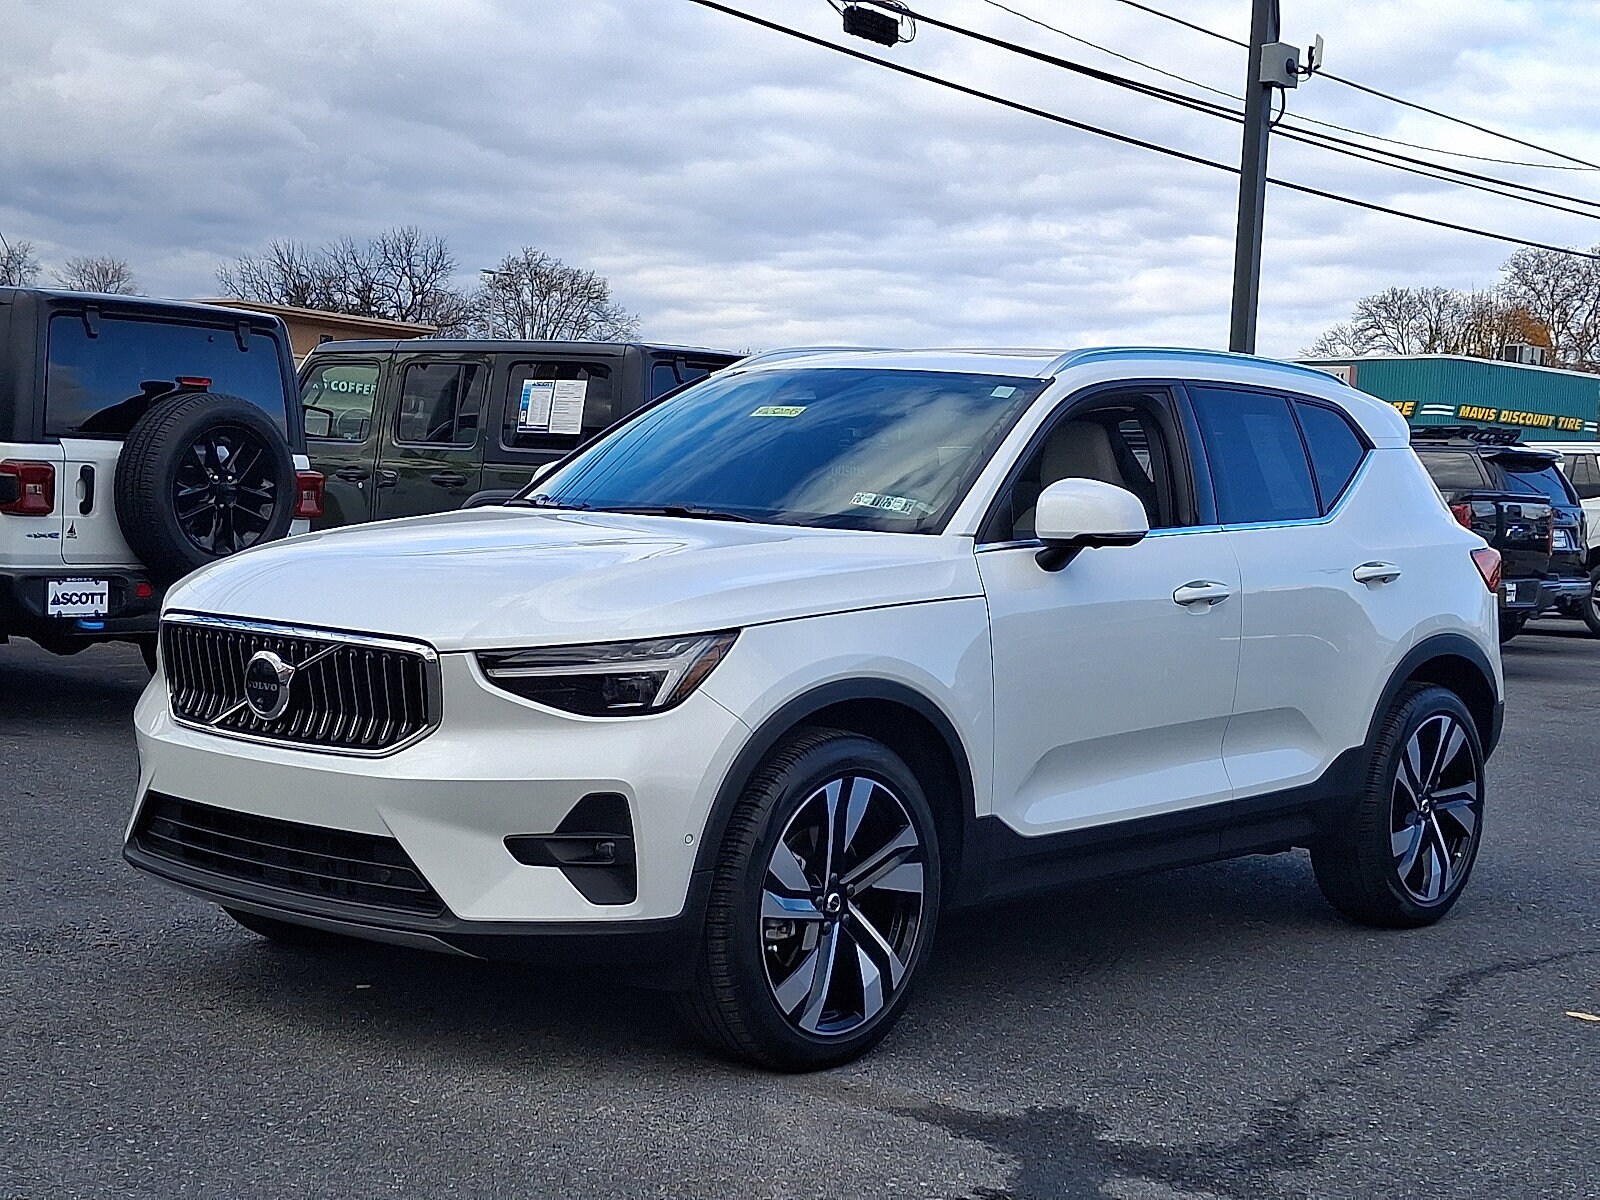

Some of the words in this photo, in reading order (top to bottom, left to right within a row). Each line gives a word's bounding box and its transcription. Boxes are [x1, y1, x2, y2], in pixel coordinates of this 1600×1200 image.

[1459, 405, 1497, 421] MAVIS
[1499, 410, 1556, 427] DISCOUNT
[1557, 416, 1583, 430] TIRE
[60, 592, 107, 605] SCOTT
